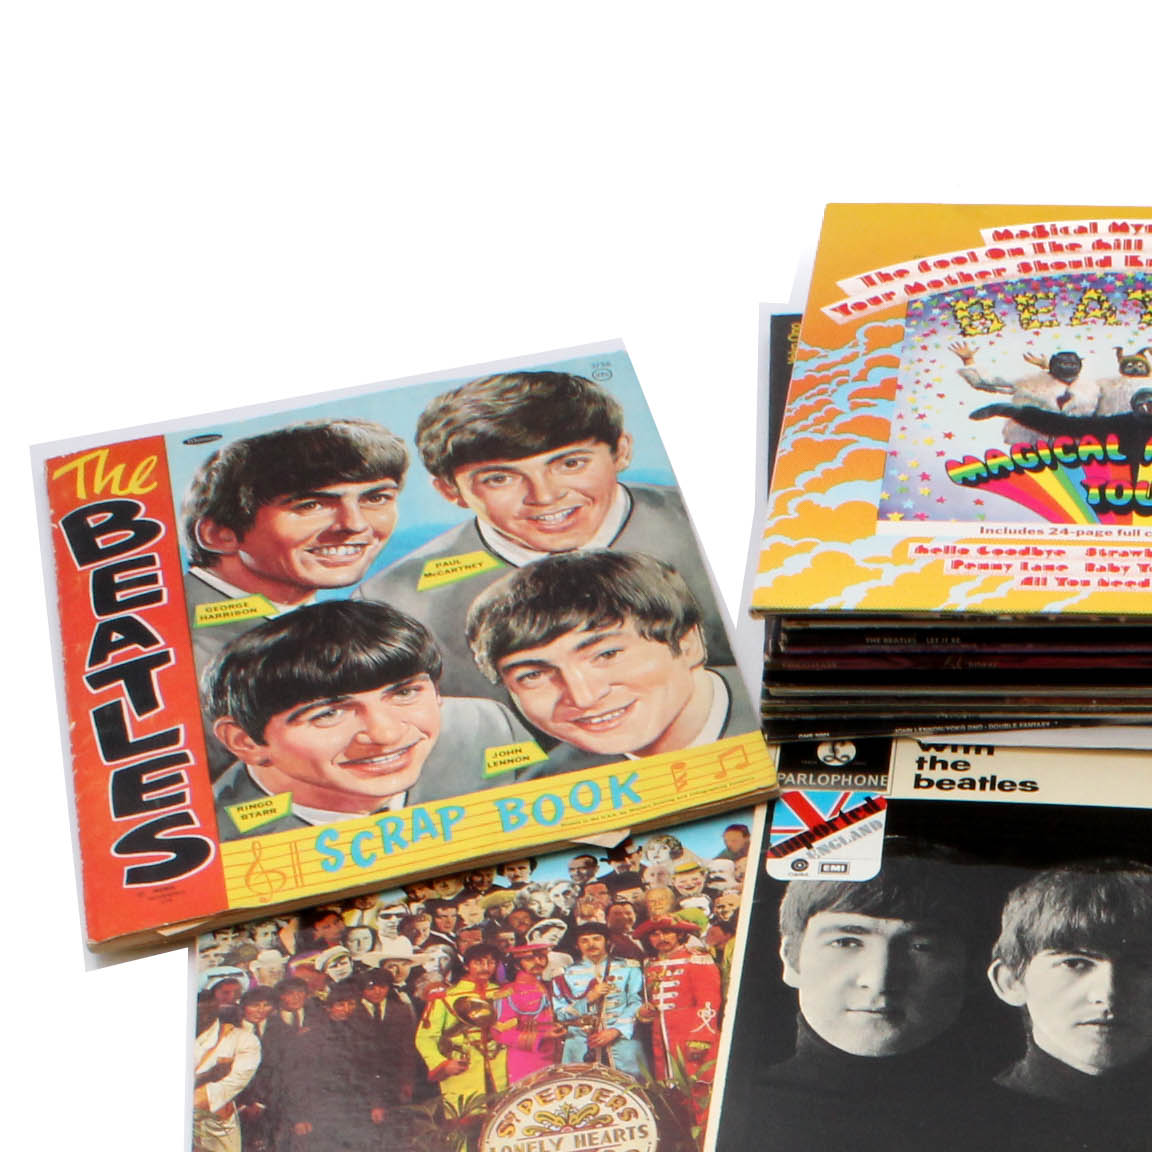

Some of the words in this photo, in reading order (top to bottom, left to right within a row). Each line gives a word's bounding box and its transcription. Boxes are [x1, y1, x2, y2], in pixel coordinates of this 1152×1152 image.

[992, 222, 1098, 241] Magical
[860, 267, 910, 288] The
[985, 246, 1025, 260] On
[1033, 242, 1082, 255] The
[832, 290, 896, 318] Your
[904, 265, 1007, 296] Mother
[1017, 255, 1112, 273] Should
[944, 433, 1128, 488] MAGICAL
[52, 448, 158, 499] The
[980, 526, 1045, 537] Includes
[1049, 527, 1113, 540] 24-page
[1116, 528, 1140, 538] full
[424, 561, 485, 578] McCARTNEY
[435, 559, 462, 568] PAUL
[950, 560, 1014, 573] Penny
[1020, 561, 1069, 573] Lane
[1084, 562, 1134, 576] Baby
[1019, 576, 1048, 587] All
[1056, 577, 1090, 588] You
[199, 607, 258, 622] HARRISON
[204, 600, 250, 614] GEORGE
[59, 498, 216, 888] BEATLES
[491, 747, 523, 759] JOHN
[486, 754, 531, 769] LENNON
[916, 756, 971, 772] the
[778, 772, 888, 787] PARLOPHONE
[913, 774, 1040, 793] beatles
[236, 799, 274, 812] RINGO
[241, 808, 277, 821] STARR
[315, 805, 467, 872] SCRAP
[493, 772, 643, 833] BOOK
[806, 820, 882, 859] ENGLAND
[822, 864, 846, 872] EMI
[516, 1083, 640, 1122] PEPPERS
[574, 1124, 649, 1149] HEARTS
